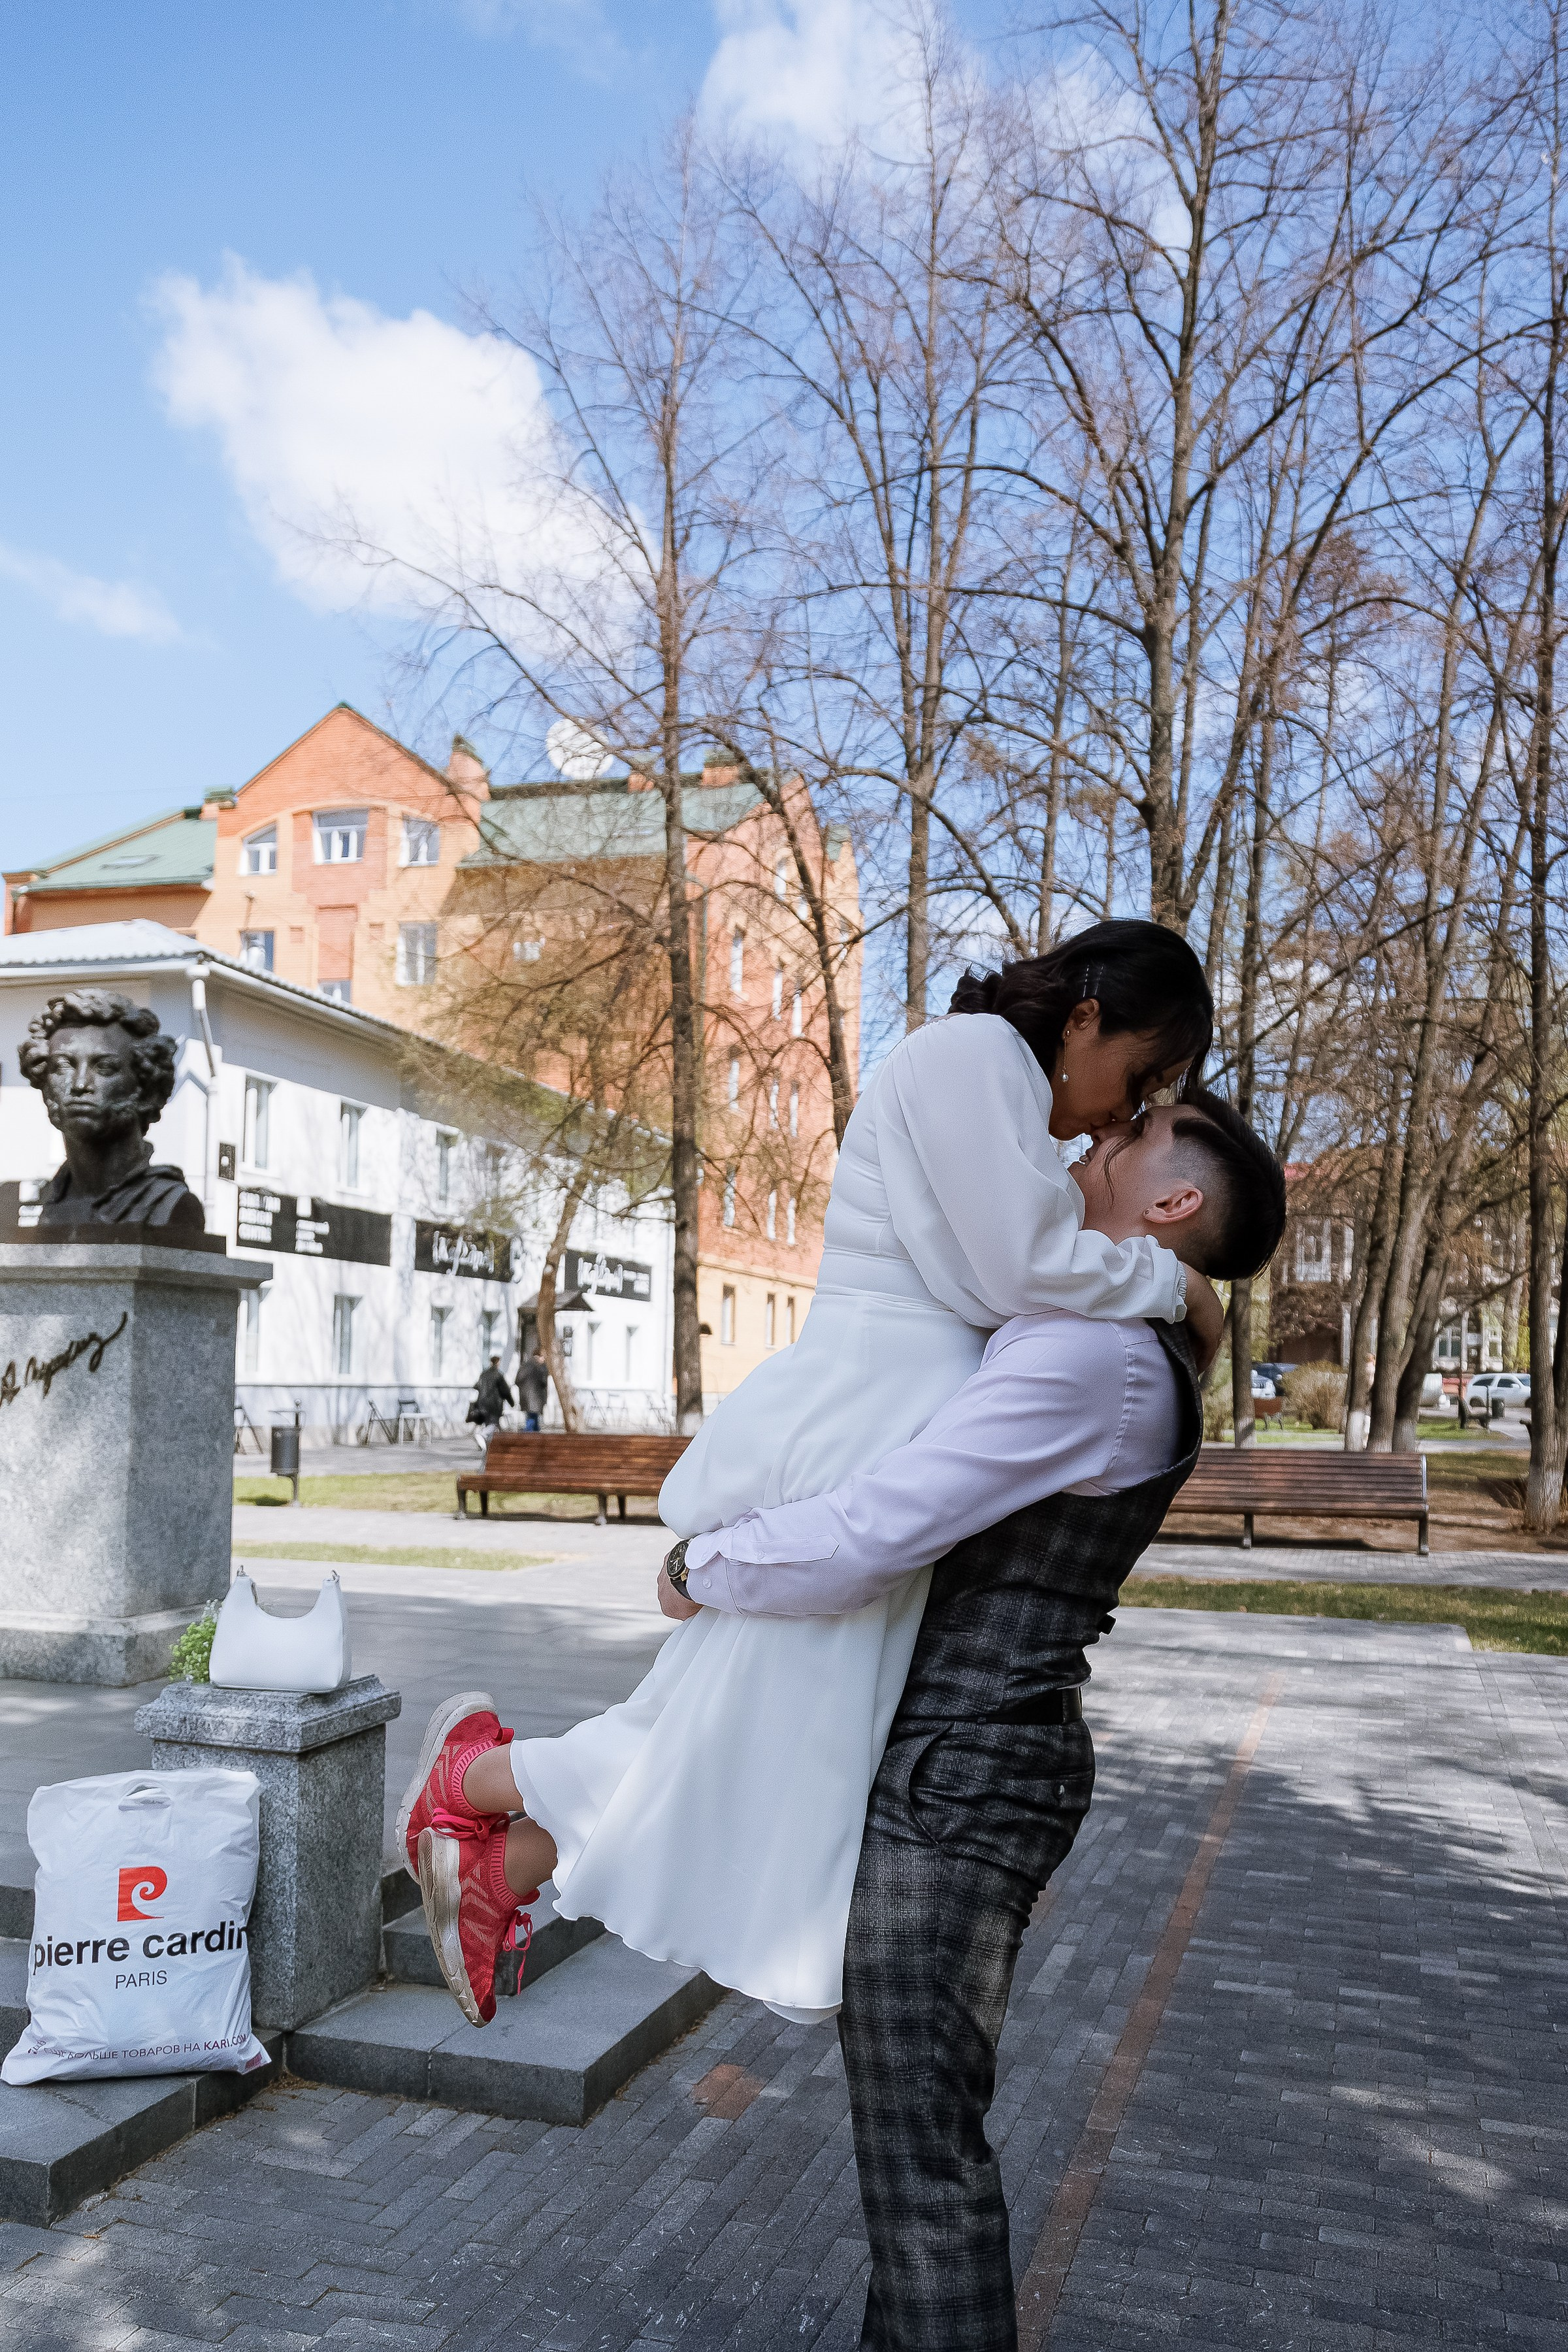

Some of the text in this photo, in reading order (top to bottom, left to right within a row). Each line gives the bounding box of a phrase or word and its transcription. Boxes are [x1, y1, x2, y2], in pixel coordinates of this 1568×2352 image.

[33, 1936, 130, 1975] pierre
[116, 1970, 167, 1989] PARIS
[122, 2044, 180, 2059] ТОВАРОВ
[184, 2042, 201, 2053] НА
[204, 2034, 248, 2051] KARI.COM
